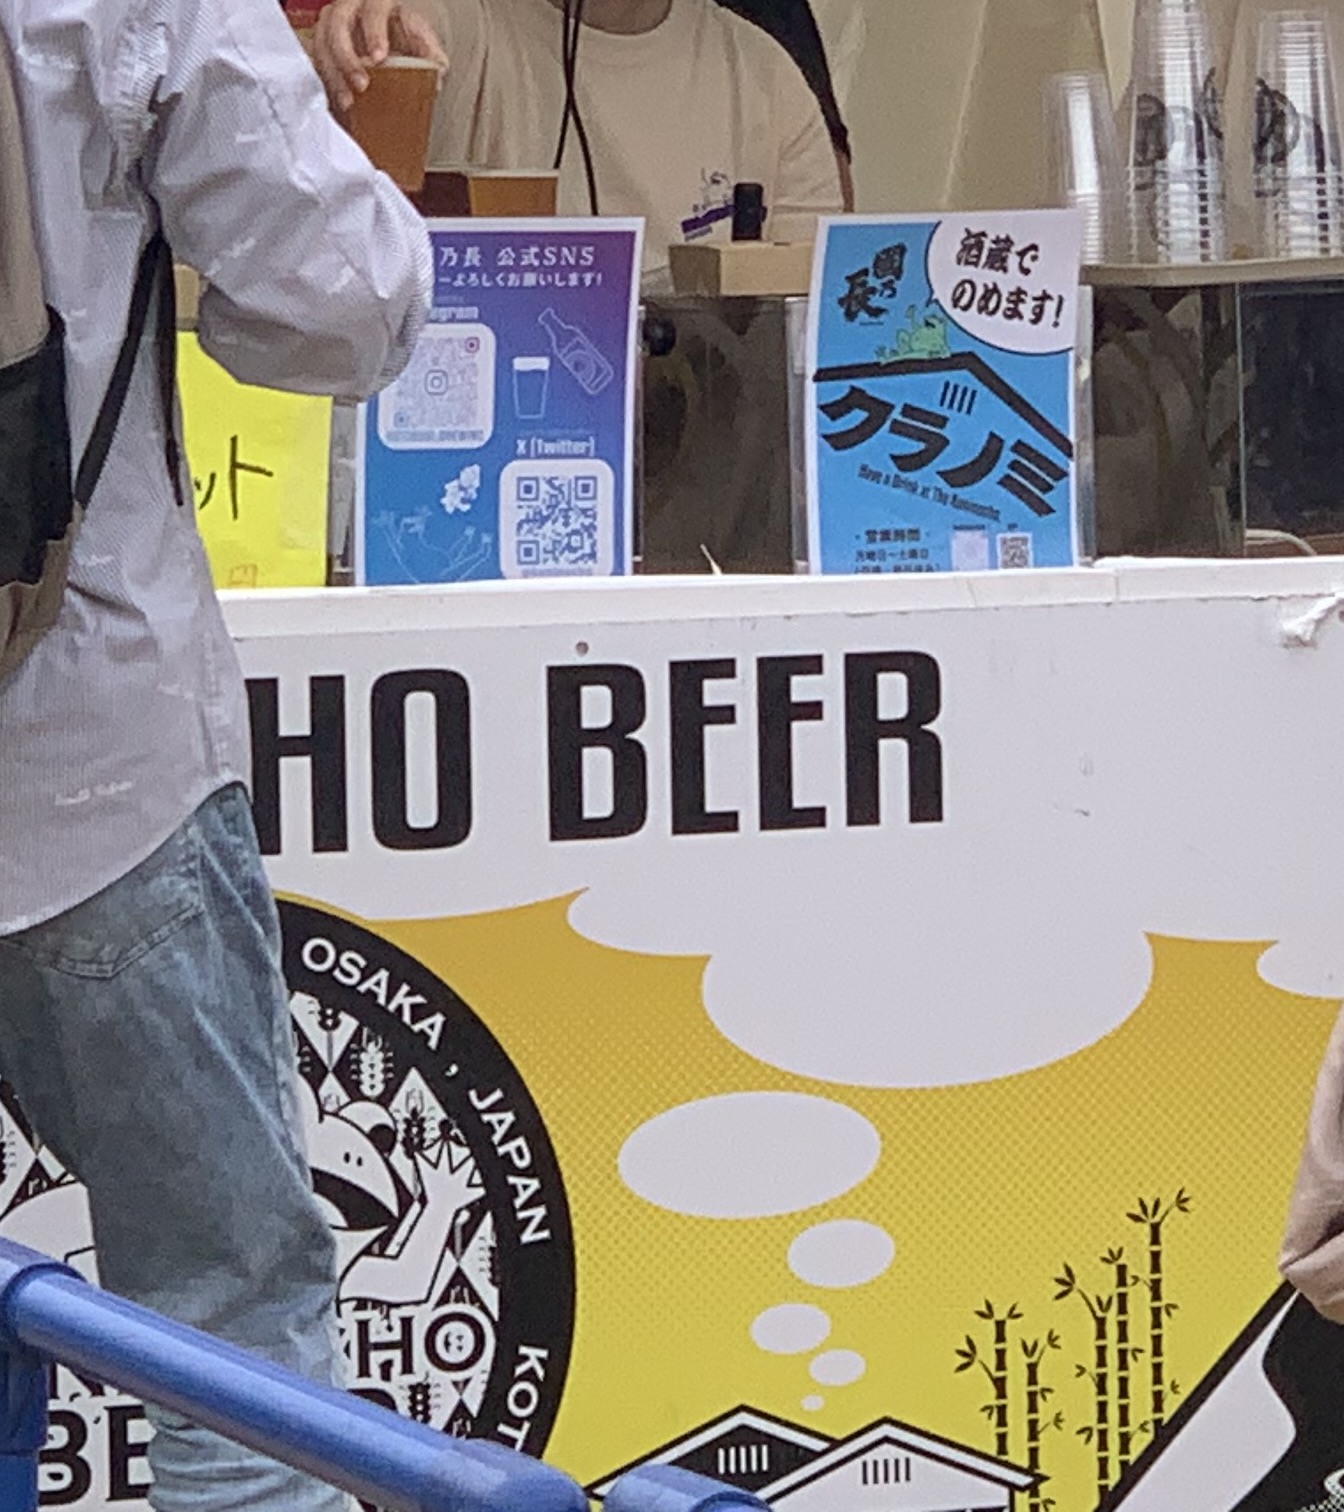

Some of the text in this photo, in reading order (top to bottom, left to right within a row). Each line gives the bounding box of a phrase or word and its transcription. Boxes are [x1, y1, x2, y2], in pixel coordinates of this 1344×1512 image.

[497, 246, 596, 268] 公式SNS
[956, 228, 1039, 276] 酒蔵で
[951, 278, 1064, 328] のめます!
[818, 385, 1069, 518] クラノミ
[547, 650, 944, 837] BEER
[470, 1087, 551, 1246] JAPAN
